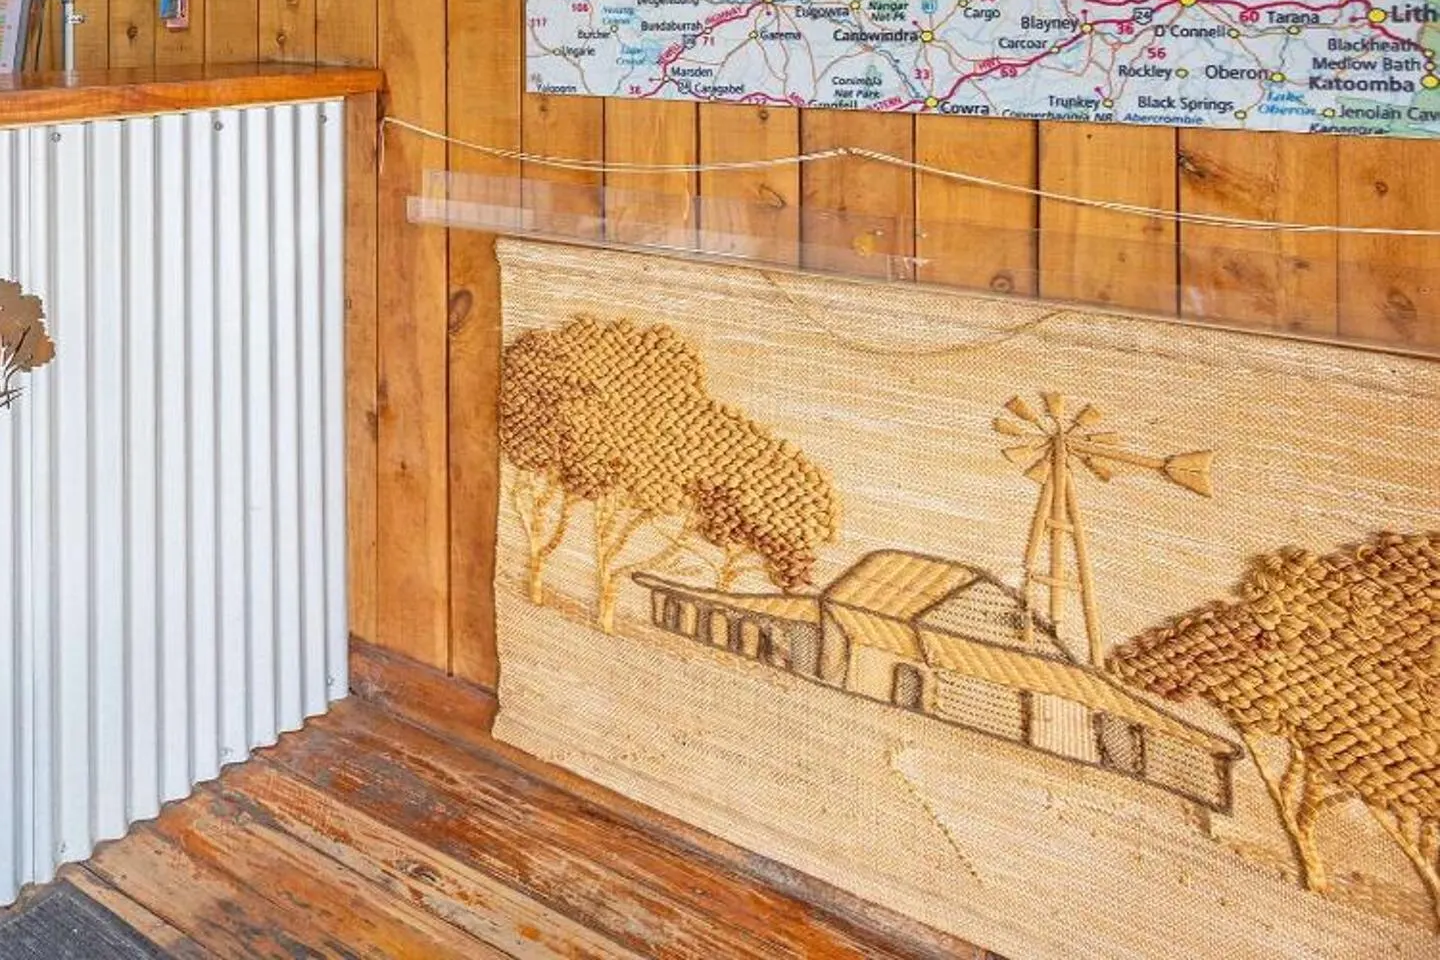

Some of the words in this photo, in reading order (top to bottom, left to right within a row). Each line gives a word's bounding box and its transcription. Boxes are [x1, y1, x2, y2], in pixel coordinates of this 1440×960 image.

[962, 7, 1001, 23] Cargo
[1239, 11, 1261, 25] 60
[1267, 10, 1320, 26] Tarana
[1391, 2, 1437, 24] Lith
[1019, 15, 1080, 34] Blayney
[832, 28, 919, 43] Canowindra
[997, 36, 1049, 50] Carcoar
[1147, 46, 1167, 61] 56
[1327, 38, 1419, 53] Blackheath
[671, 66, 713, 78] Marsden
[1312, 56, 1378, 72] Medlow
[1381, 56, 1422, 72] Bath
[1117, 65, 1173, 82] Rockley
[1204, 64, 1271, 81] Oberon
[1309, 75, 1416, 92] Katoomba
[940, 101, 991, 115] Cowra
[1046, 94, 1101, 111] Trunkey
[1137, 95, 1176, 109] Black
[1178, 96, 1234, 113] Springs
[1338, 104, 1402, 121] Jenolan
